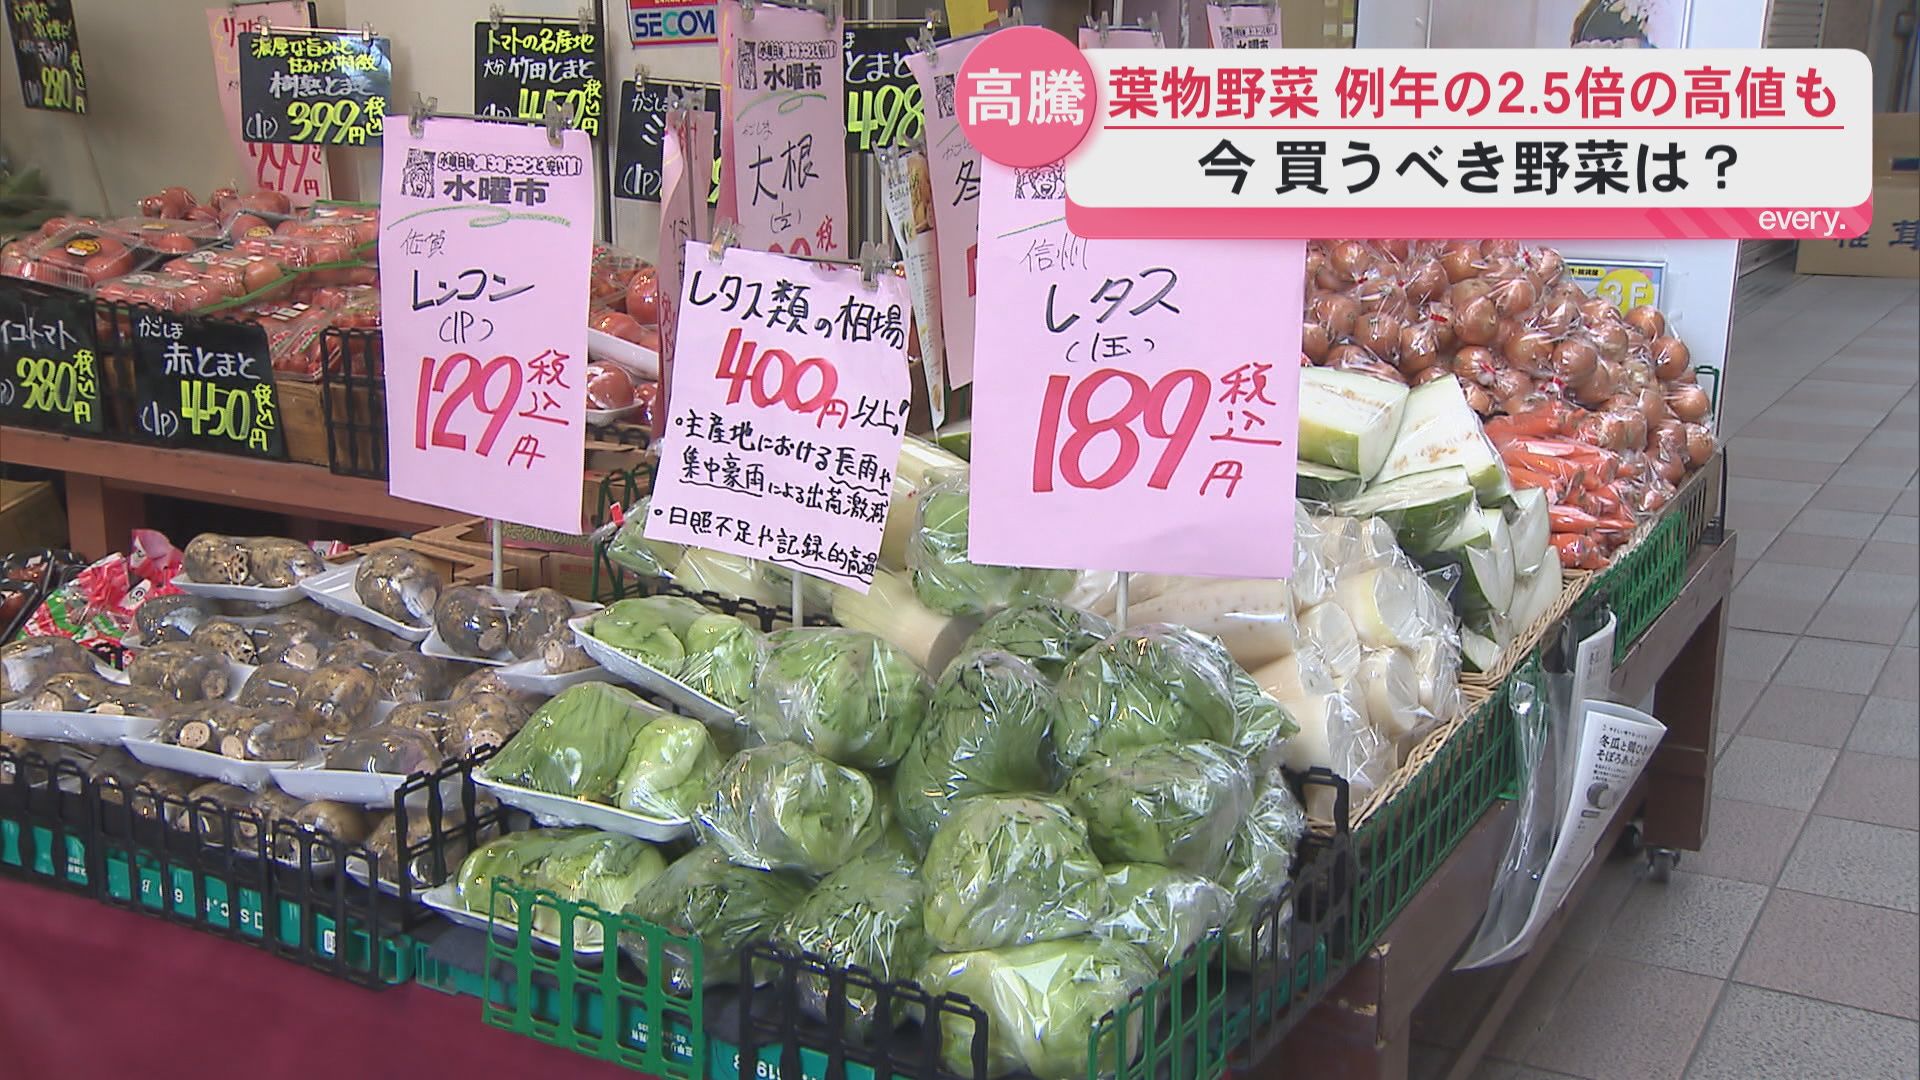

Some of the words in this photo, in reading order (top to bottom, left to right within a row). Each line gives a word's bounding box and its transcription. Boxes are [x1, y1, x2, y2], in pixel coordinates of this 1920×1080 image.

[488, 27, 595, 54] トマトの名産地
[635, 10, 715, 37] SECOM
[251, 37, 355, 58] 濃厚な旨みと
[288, 54, 378, 75] 甘みが特徴
[508, 55, 596, 85] 竹田とまと
[763, 62, 822, 91] 水曜市
[847, 84, 925, 150] 498
[748, 133, 820, 207] 大根
[443, 174, 551, 207] 水曜市
[400, 227, 447, 259] 佐賀
[1019, 233, 1088, 273] 信州
[411, 268, 536, 312] レンコン
[688, 269, 905, 350] レタス類の相場
[1045, 267, 1181, 334] レタス
[163, 342, 261, 381] 赤とまと
[16, 357, 77, 413] 380
[180, 380, 251, 440] 450
